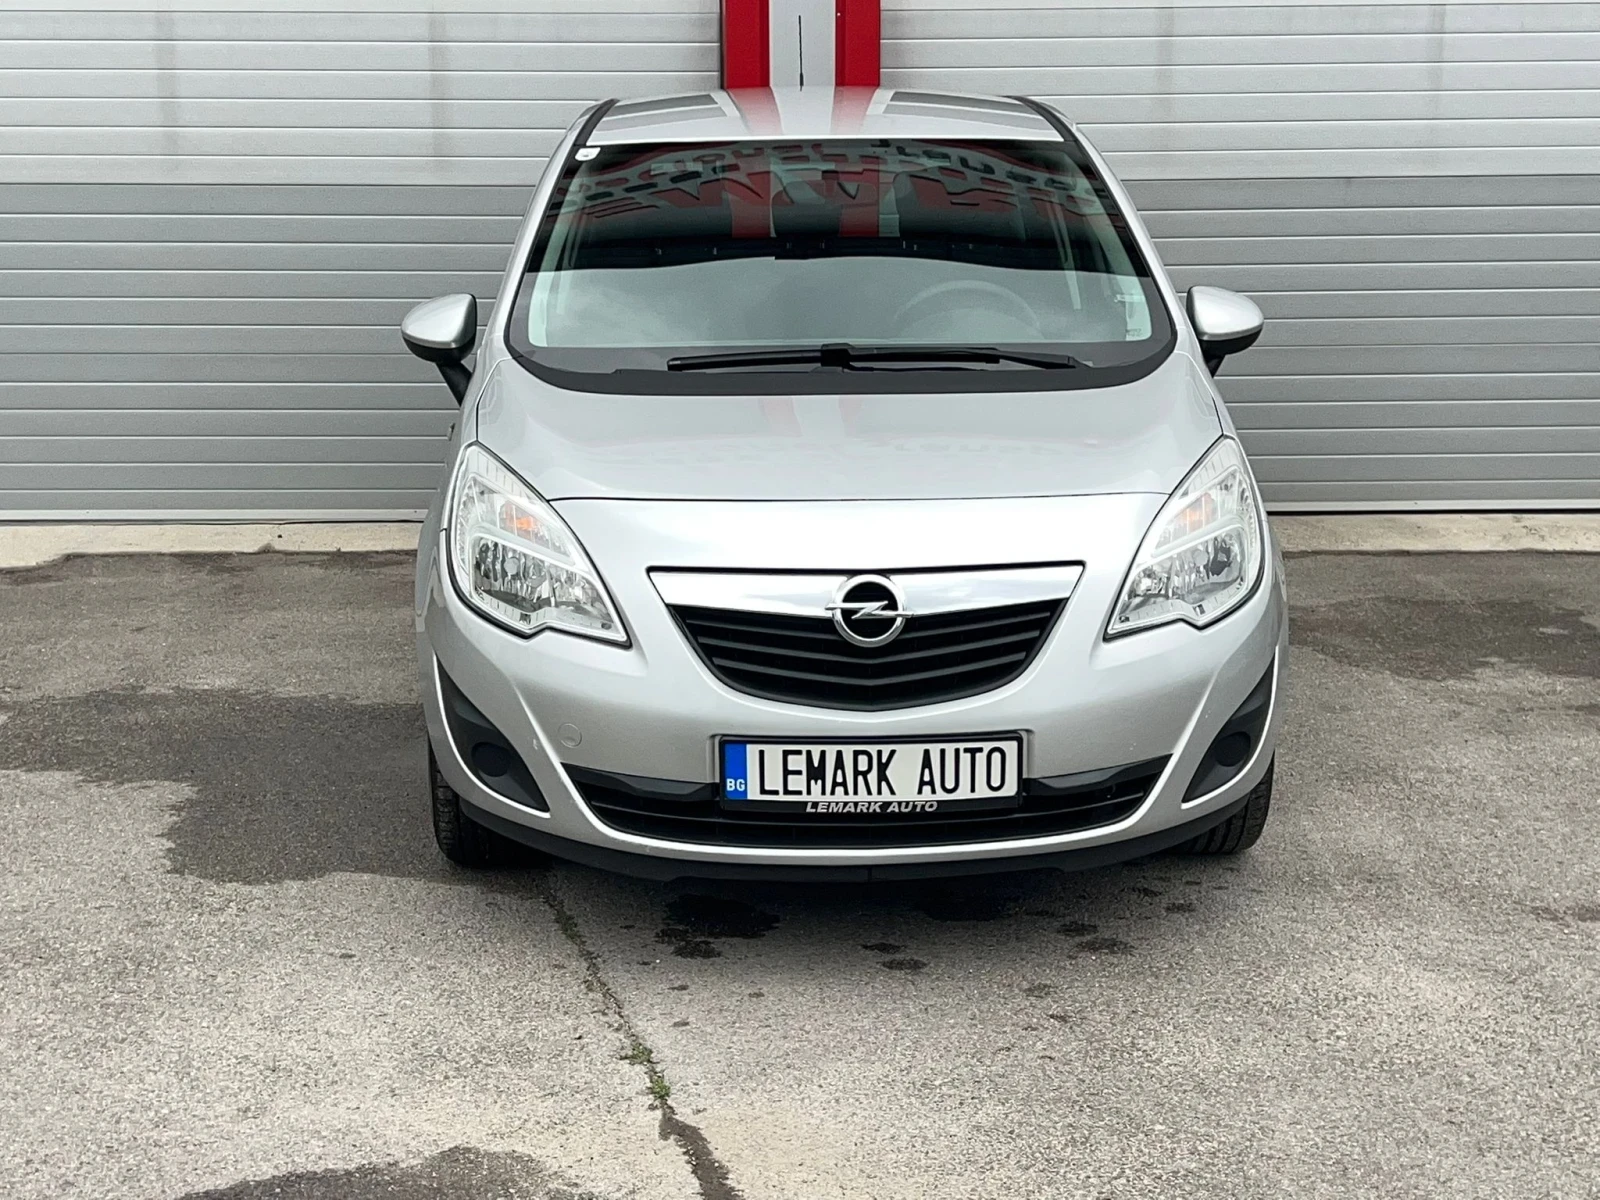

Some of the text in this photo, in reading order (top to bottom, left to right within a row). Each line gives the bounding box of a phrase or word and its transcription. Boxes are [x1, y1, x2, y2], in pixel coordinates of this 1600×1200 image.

[758, 746, 1007, 796] LEMARK AUTO
[726, 778, 746, 792] BG
[805, 800, 938, 814] LEMARK AUTO
